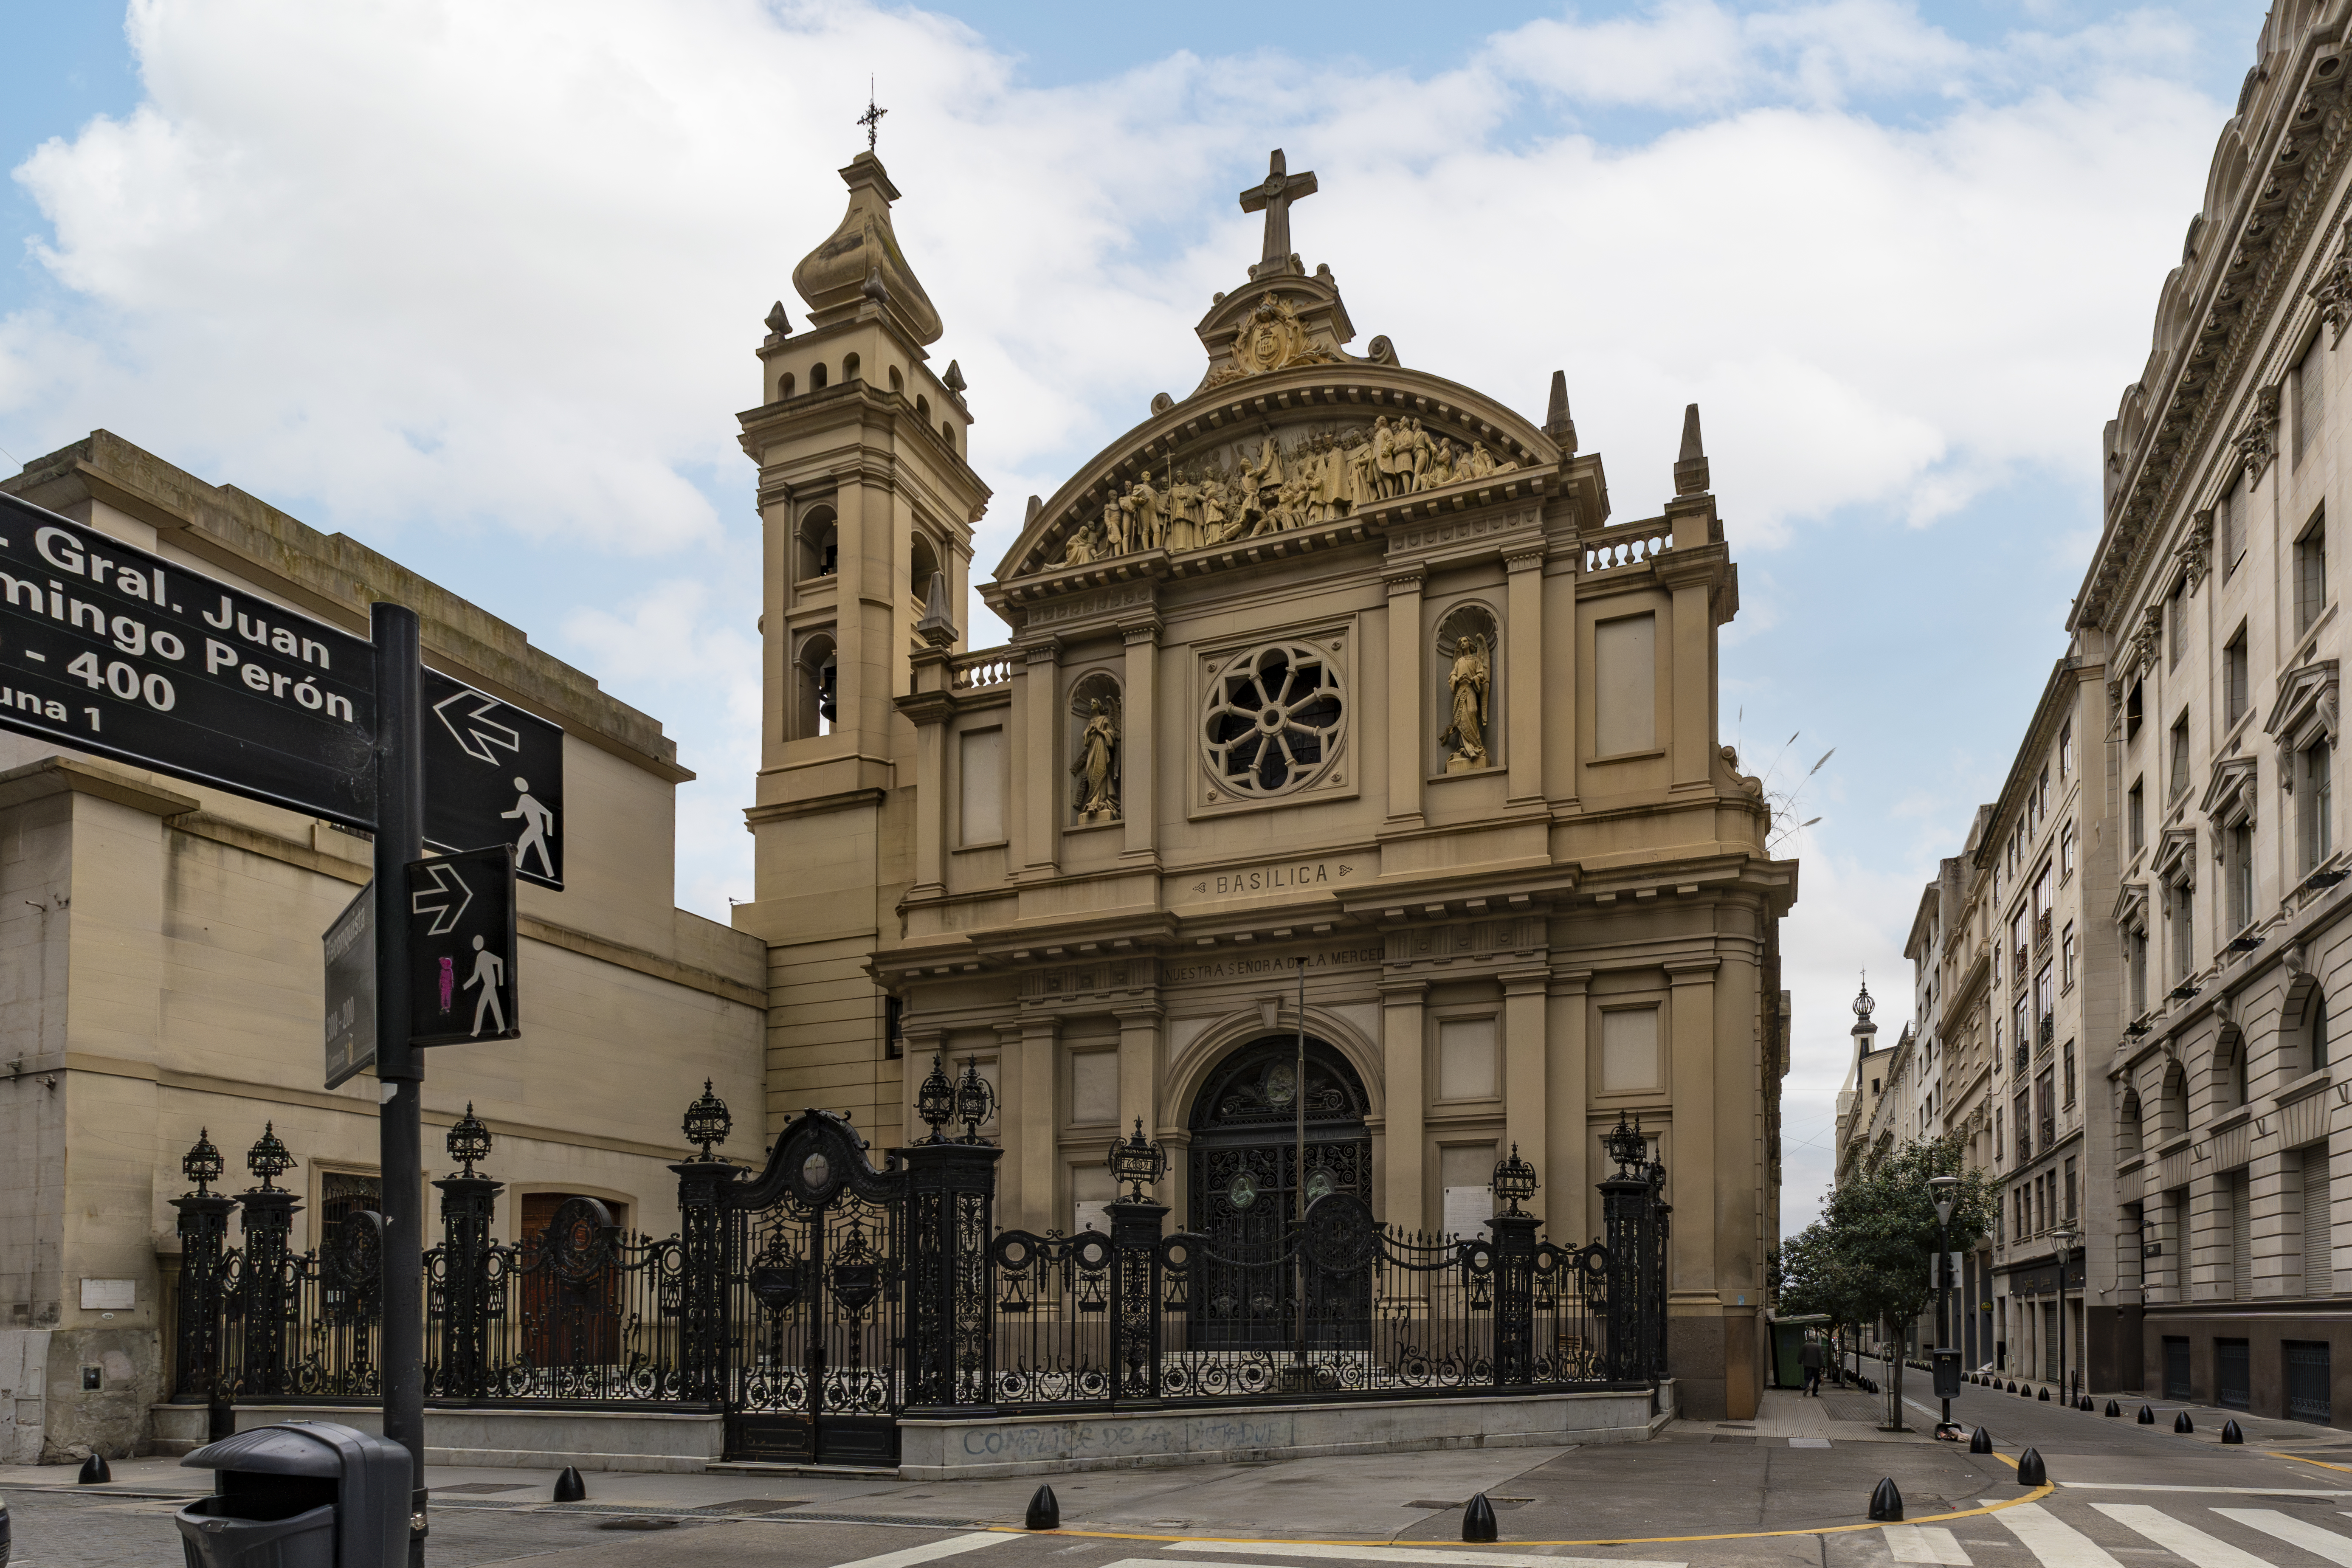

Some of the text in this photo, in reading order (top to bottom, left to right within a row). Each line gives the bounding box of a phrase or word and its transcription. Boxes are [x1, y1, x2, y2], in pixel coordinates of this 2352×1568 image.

[36, 527, 329, 670] Gral. Juan
[68, 652, 175, 711] 400
[206, 638, 353, 723] Perón
[85, 708, 100, 732] 1
[1217, 864, 1327, 894] BASÍLICA
[1166, 963, 1224, 982] NUESTRA
[1307, 954, 1327, 967] LA
[1332, 948, 1385, 965] MERCED
[343, 996, 354, 1029] 200
